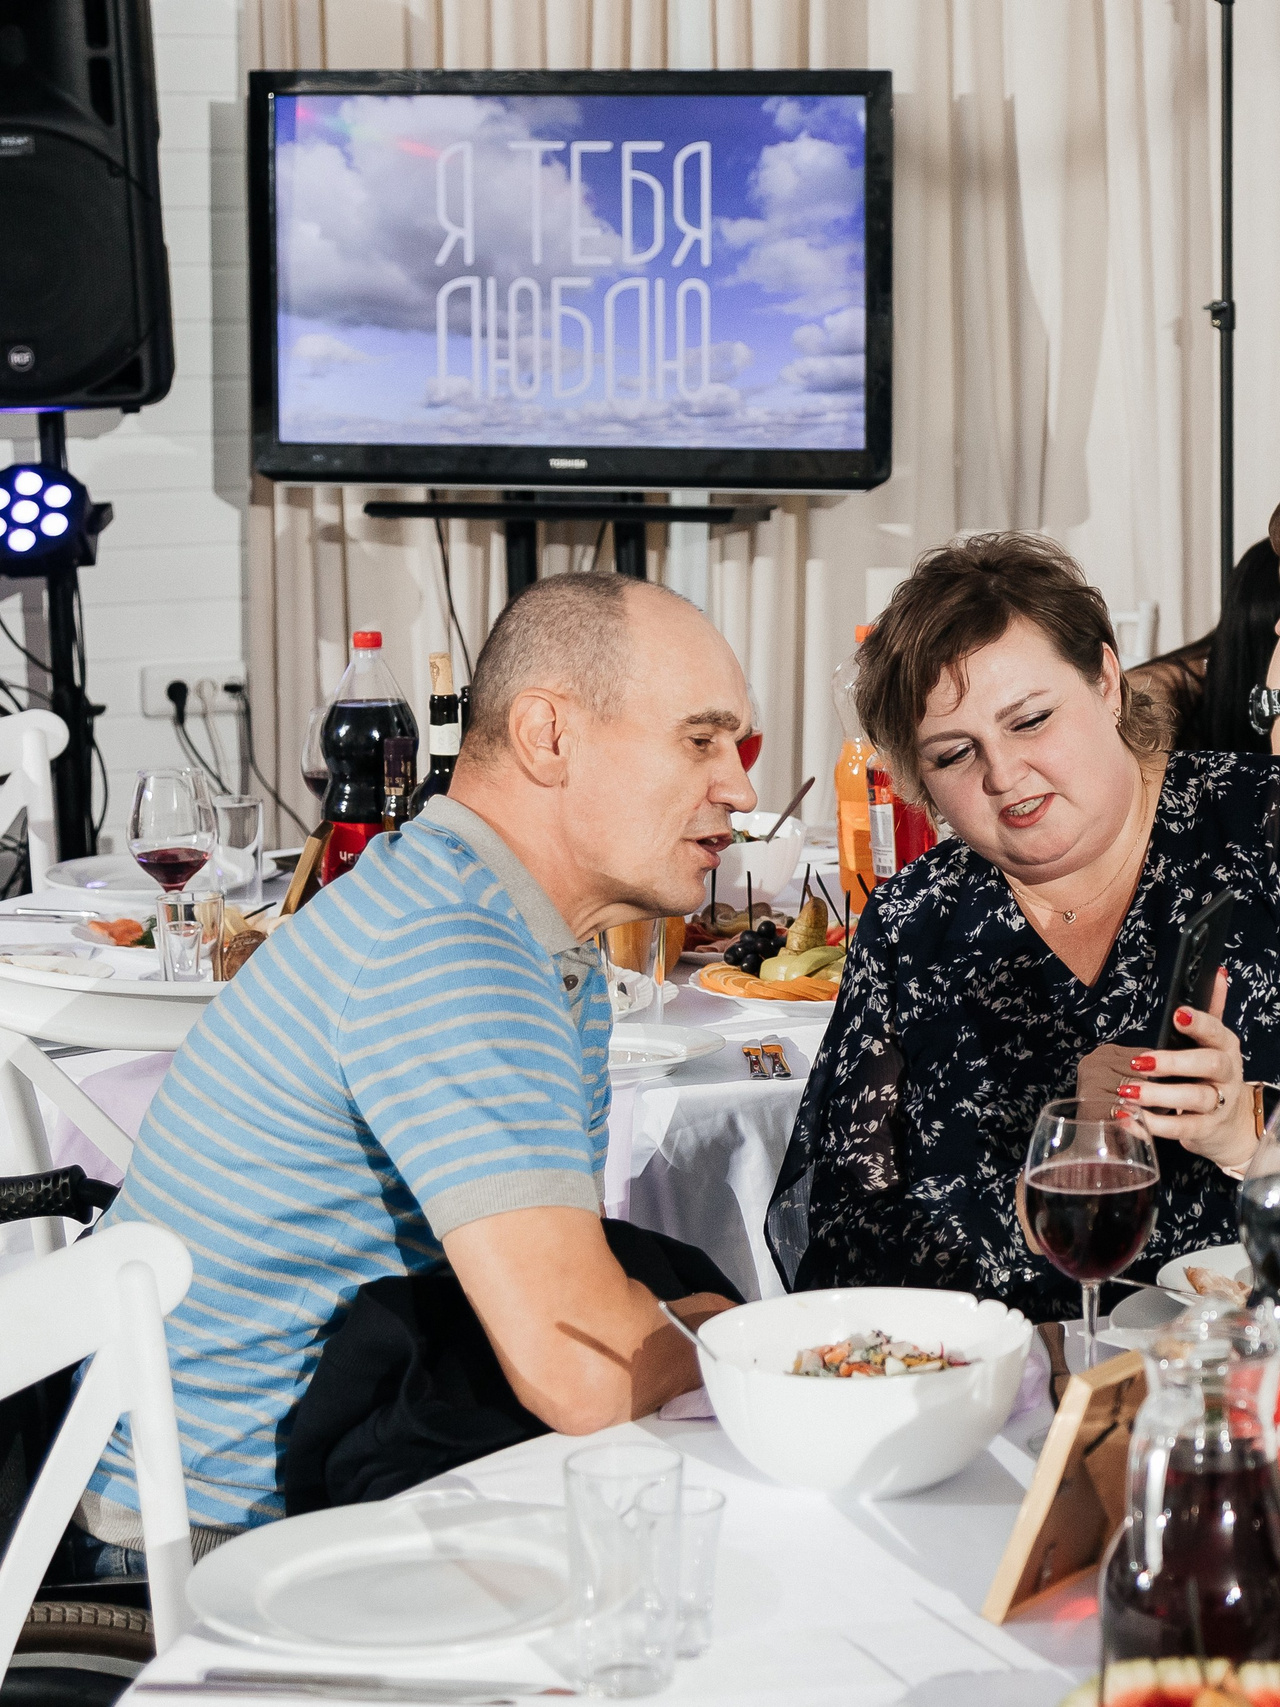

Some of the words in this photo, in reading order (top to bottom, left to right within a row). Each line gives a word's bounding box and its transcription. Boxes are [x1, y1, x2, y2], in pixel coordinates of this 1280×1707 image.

[434, 140, 475, 267] Я
[507, 140, 713, 268] ТЕБЯ
[436, 275, 712, 402] ЛЮБЛЮ
